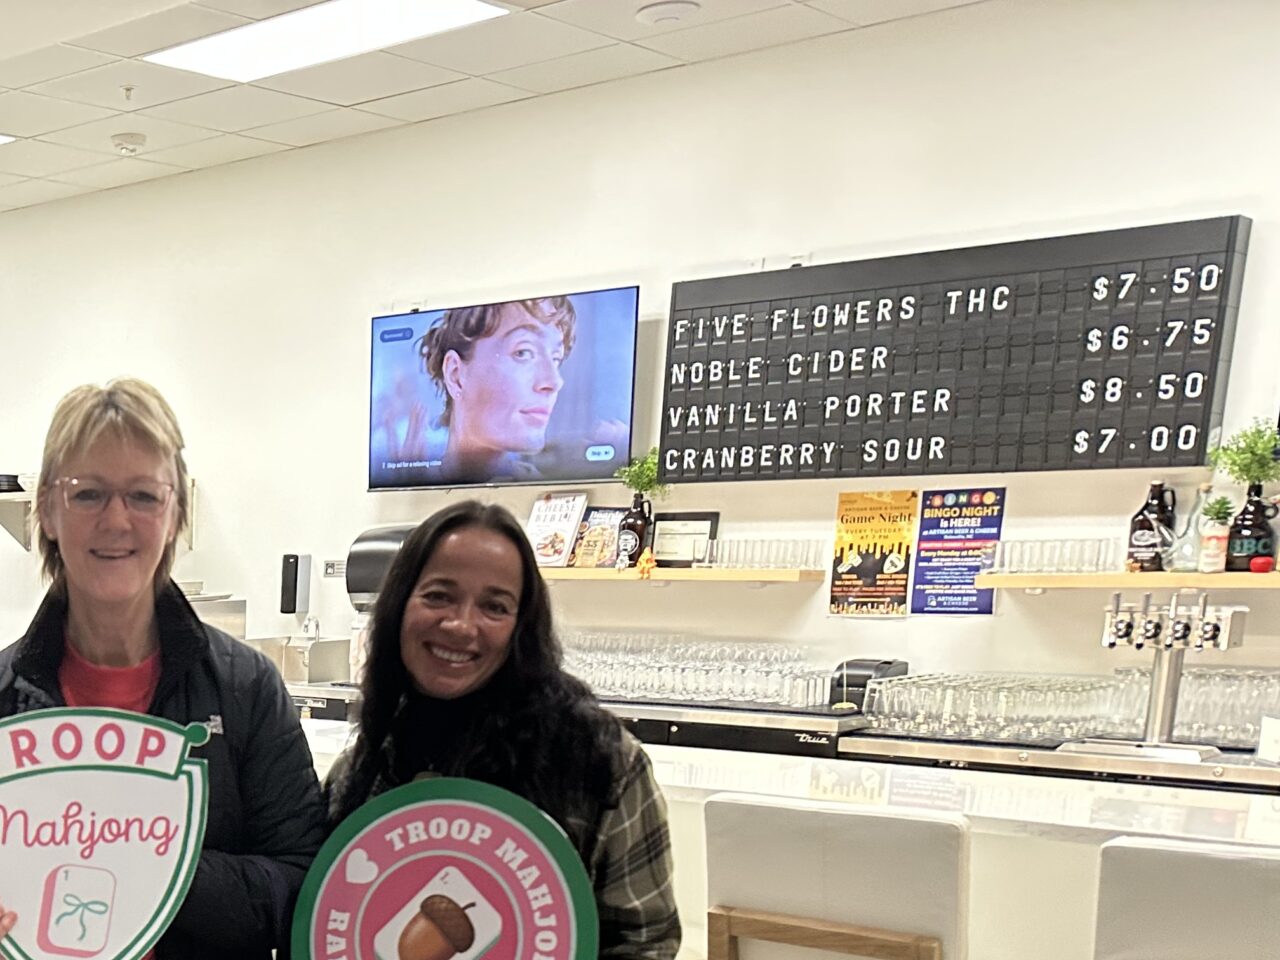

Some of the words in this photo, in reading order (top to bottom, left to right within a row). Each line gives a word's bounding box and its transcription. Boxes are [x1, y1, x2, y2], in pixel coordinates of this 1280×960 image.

[675, 313, 747, 341] FIVE
[771, 296, 916, 332] FLOWERS
[947, 286, 1011, 316] THC
[1093, 264, 1220, 300] $7.50
[671, 357, 763, 385] NOBLE
[788, 346, 889, 376] CIDER
[1086, 318, 1212, 352] $6.75
[669, 399, 799, 428] VANILLA
[824, 388, 952, 419] PORTER
[1080, 372, 1204, 403] $8.50
[665, 441, 837, 471] CRANBERRY
[862, 436, 946, 462] SOUR
[1074, 424, 1197, 454] $7.00
[537, 503, 578, 513] CHEESE
[840, 513, 875, 525] Game
[880, 512, 912, 525] Night
[923, 507, 960, 518] BINGO
[961, 505, 1000, 517] NIGHT
[950, 517, 982, 528] HERE!
[385, 817, 492, 852] TROOP
